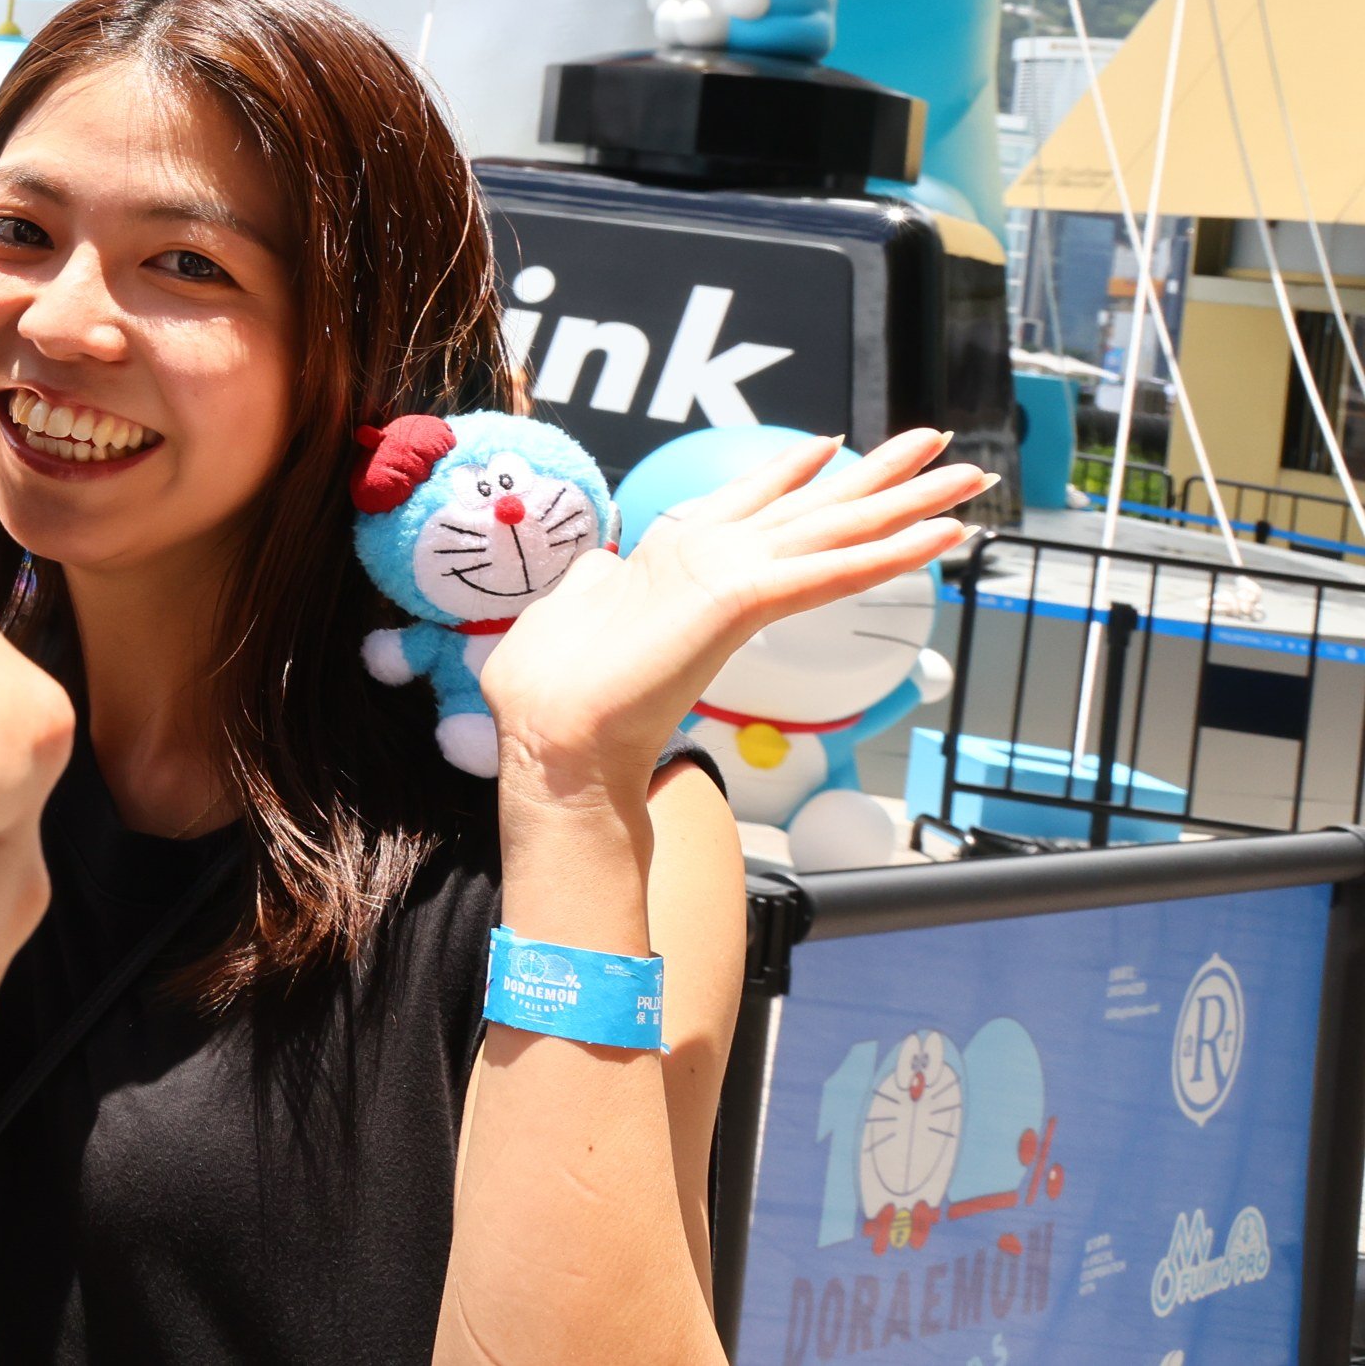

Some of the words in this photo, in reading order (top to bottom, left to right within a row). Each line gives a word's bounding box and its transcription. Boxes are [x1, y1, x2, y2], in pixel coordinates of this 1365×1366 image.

[503, 974, 579, 1006] DORAEMON
[518, 998, 566, 1013] FRIENDS
[1231, 1246, 1270, 1286] PRO
[783, 1220, 1055, 1366] DORAEMON
